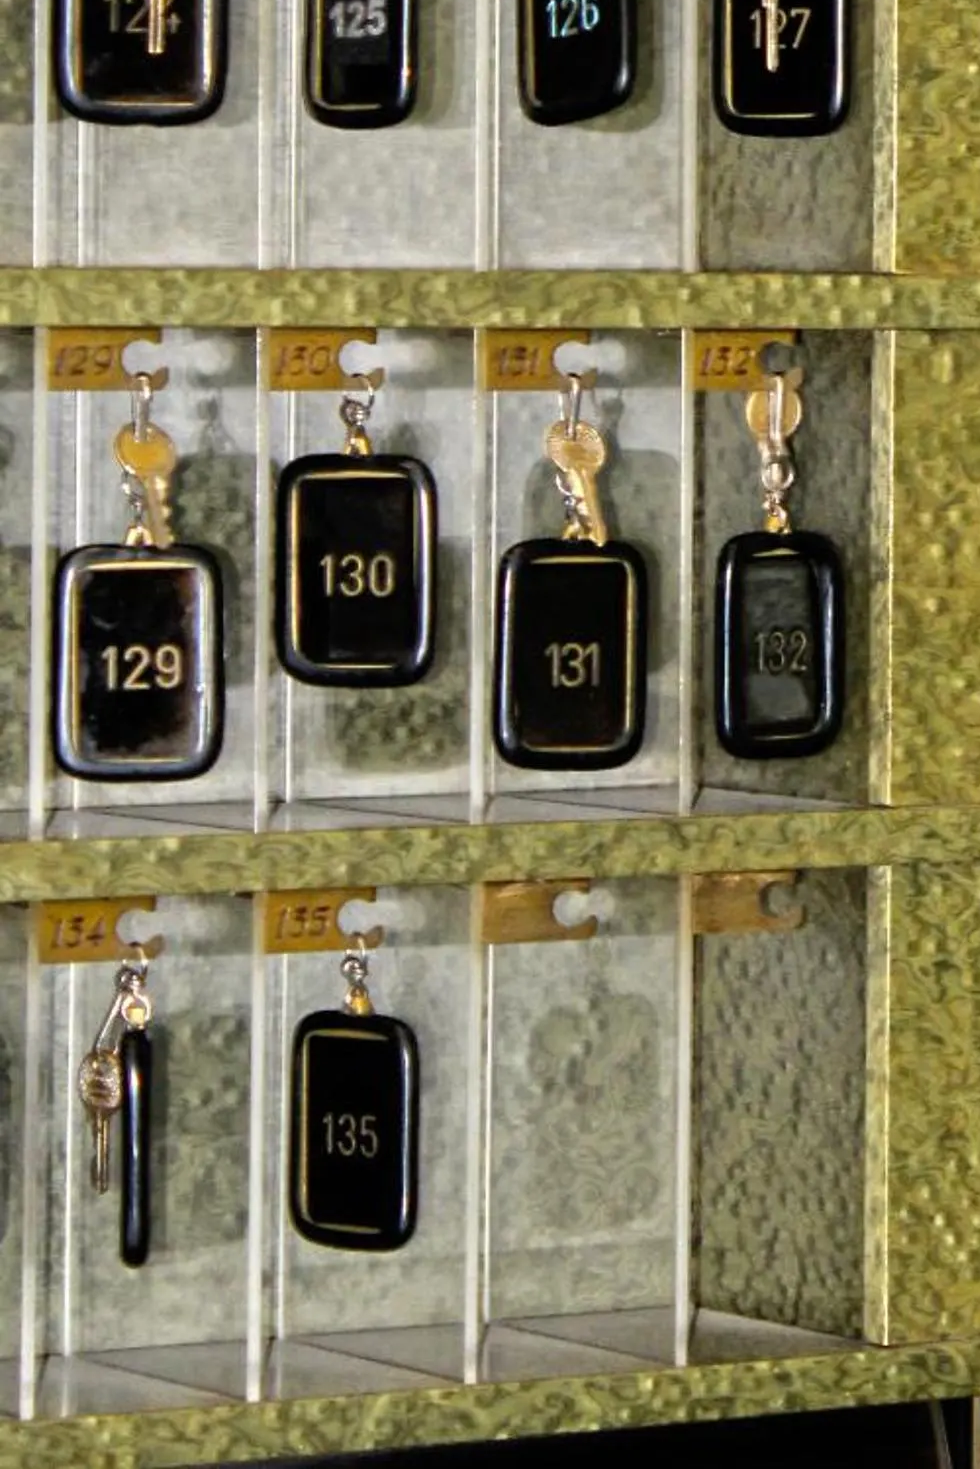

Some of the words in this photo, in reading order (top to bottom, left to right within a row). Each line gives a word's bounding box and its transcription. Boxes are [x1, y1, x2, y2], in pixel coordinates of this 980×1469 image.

[57, 344, 116, 375] 129
[320, 552, 393, 598] 130
[102, 644, 182, 691] 129
[544, 642, 600, 686] 131
[754, 630, 808, 673] 132
[321, 1113, 379, 1158] 135
